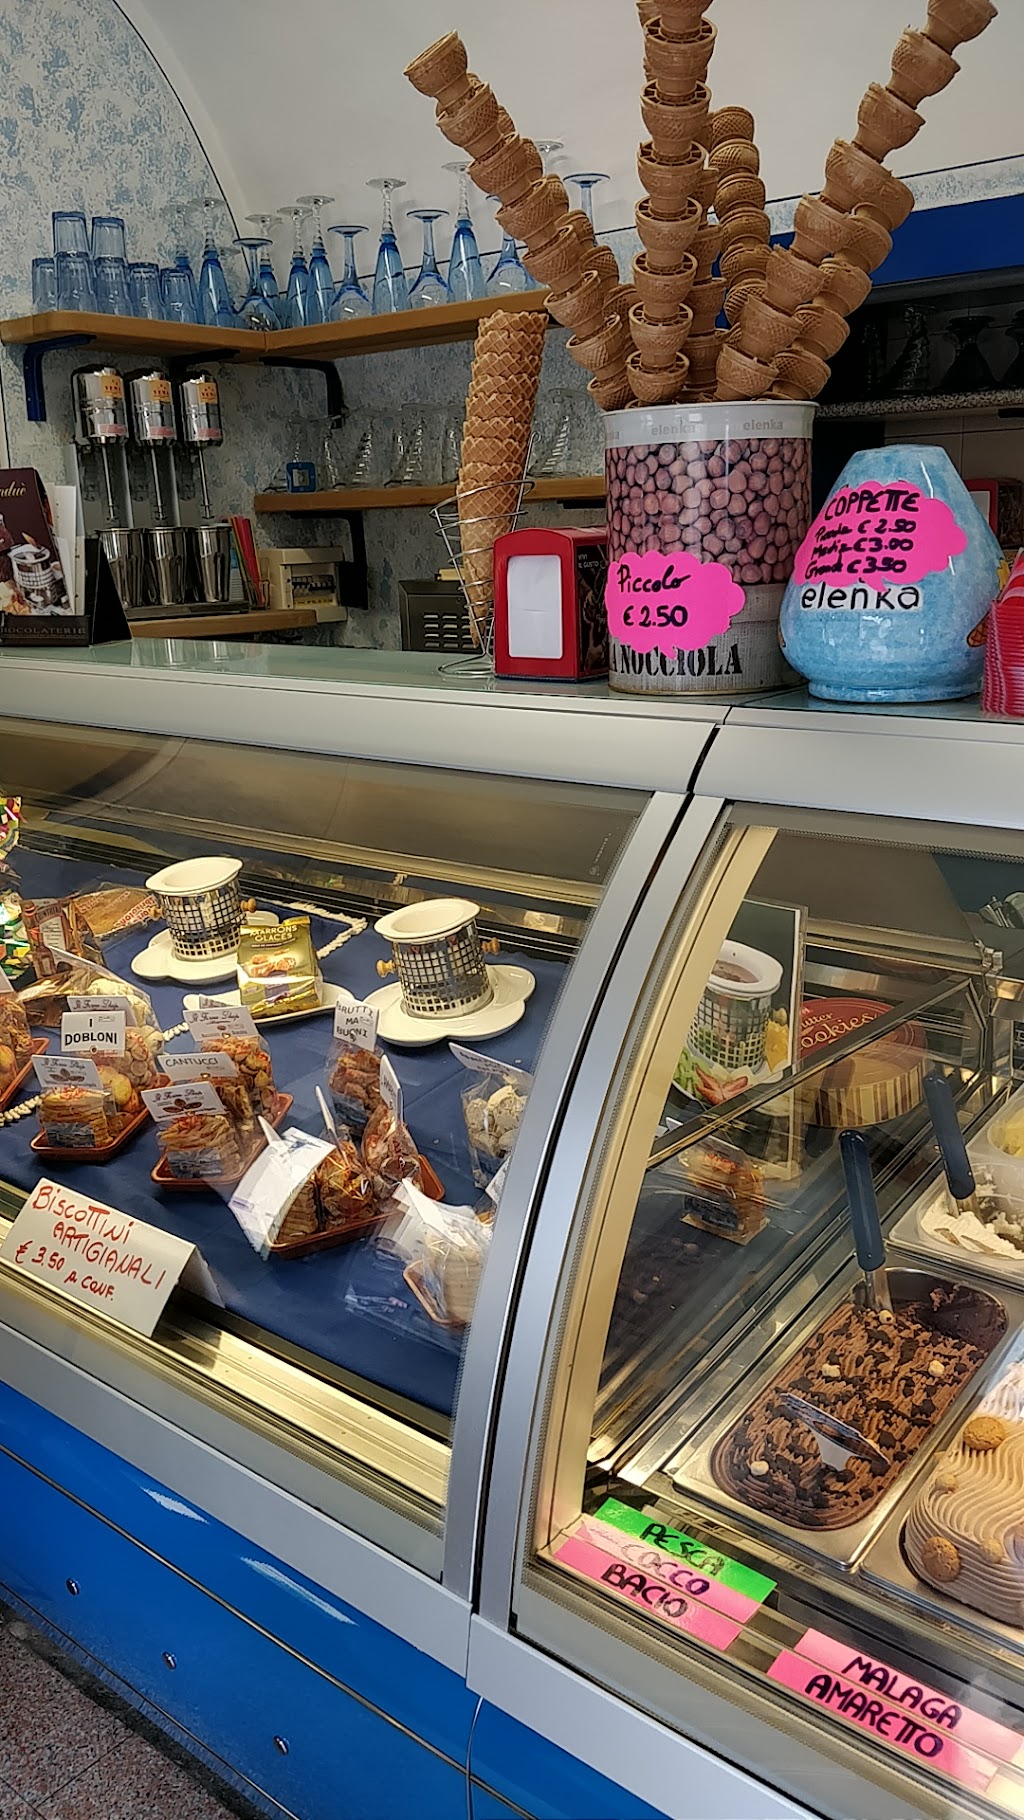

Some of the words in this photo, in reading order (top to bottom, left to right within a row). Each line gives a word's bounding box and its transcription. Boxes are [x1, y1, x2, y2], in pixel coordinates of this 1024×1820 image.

[651, 421, 696, 436] elenka
[743, 419, 784, 431] elenka
[824, 488, 921, 521] COPPETTE
[857, 519, 872, 534] €
[874, 518, 917, 534] 2.50
[853, 537, 868, 553] €
[868, 537, 914, 553] 3.00
[583, 560, 600, 569] GUSTO
[846, 559, 862, 574] €
[617, 564, 692, 594] Piccolo
[801, 581, 921, 610] elenka
[622, 605, 635, 627] €
[638, 605, 689, 628] 2.50
[249, 924, 298, 937] MARRONS
[88, 1018, 93, 1028] I
[345, 1016, 360, 1026] MA
[799, 1013, 834, 1029] utter
[64, 1031, 118, 1047] DOBLONI
[336, 1025, 369, 1039] BUONI
[799, 1013, 878, 1049] ookies
[164, 1057, 219, 1068] CANTUCCI
[14, 1240, 34, 1265] €
[31, 1246, 66, 1272] 3.50
[52, 1221, 167, 1290] ARTIGIANALI
[639, 1522, 726, 1577] PESCA
[620, 1543, 711, 1596] COCCO
[600, 1562, 689, 1619] BACIO
[840, 1655, 963, 1730] MALAGA
[804, 1673, 945, 1759] AMARETTO
